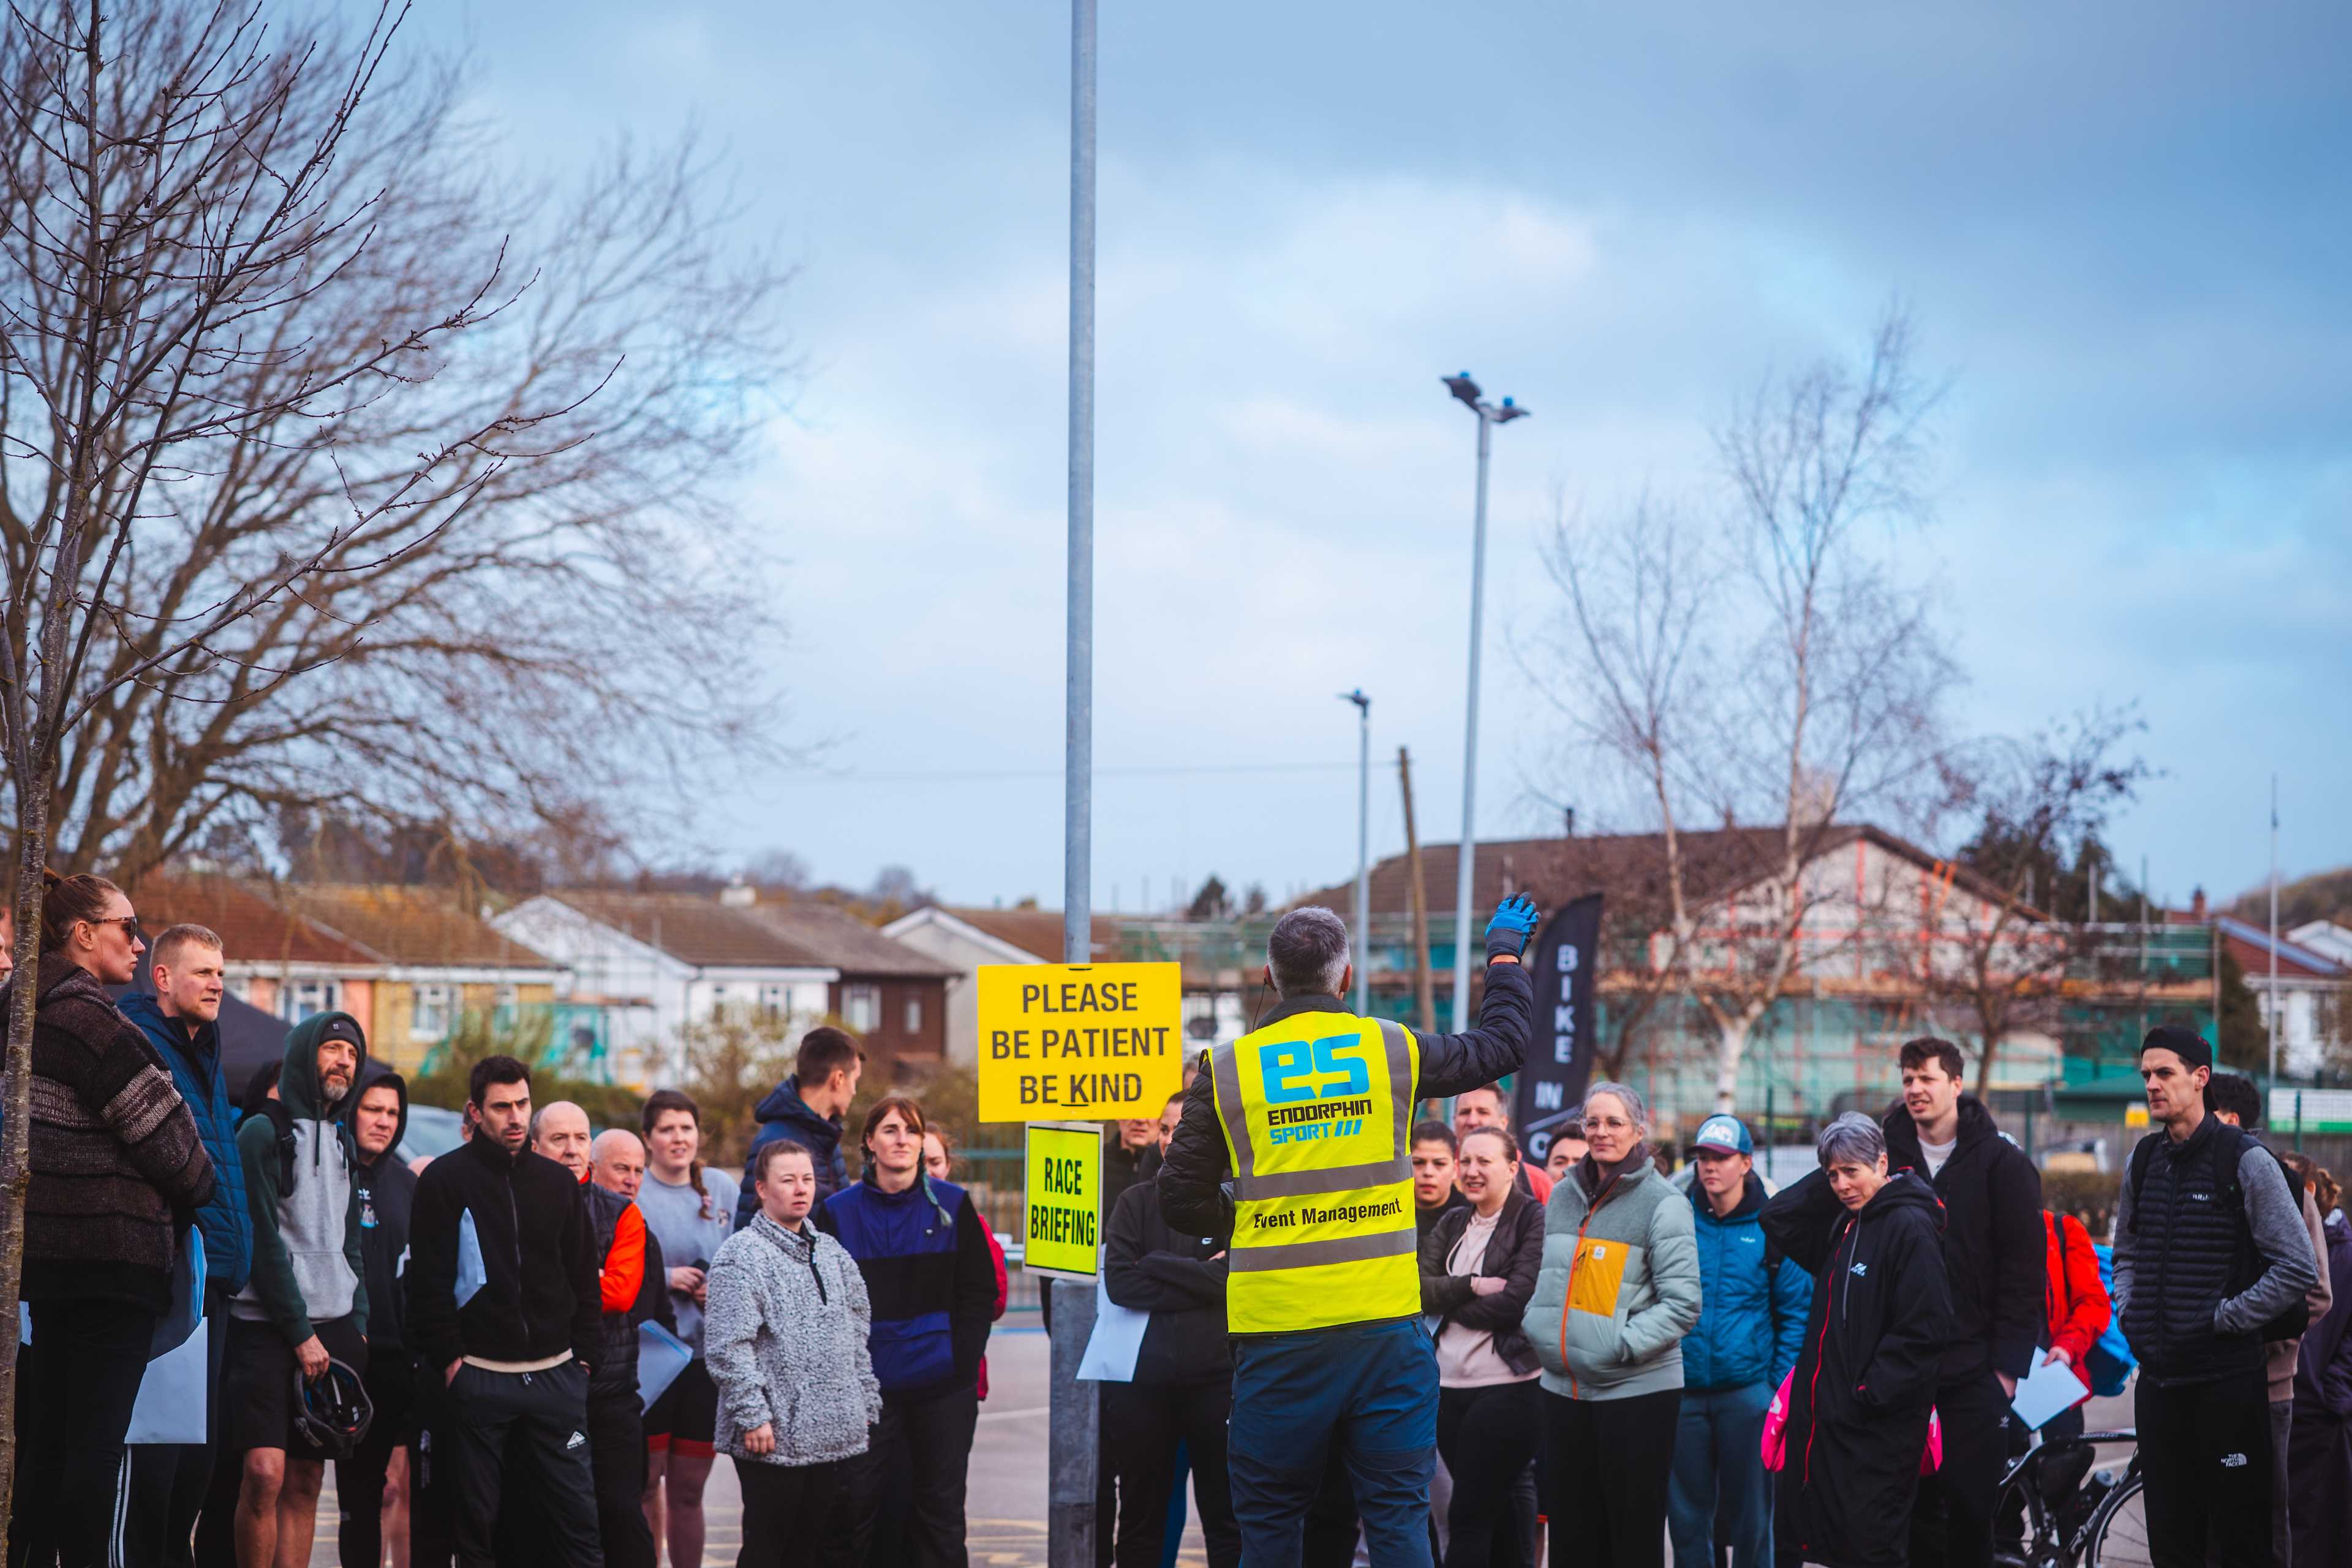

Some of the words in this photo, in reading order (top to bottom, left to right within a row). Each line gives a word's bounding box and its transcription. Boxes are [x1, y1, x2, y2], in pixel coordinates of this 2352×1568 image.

[1022, 982, 1138, 1013] PLEASE
[1554, 944, 1578, 1064] BIKE
[992, 1030, 1030, 1060] BE
[1042, 1027, 1170, 1058] PATIENT
[1020, 1075, 1058, 1104] BE
[1070, 1073, 1142, 1103] KIND
[1535, 1081, 1564, 1110] IN
[1267, 1099, 1373, 1126] ENDORPHIN
[1270, 1121, 1333, 1145] SPORT
[1044, 1157, 1082, 1196] RACE
[1030, 1205, 1095, 1247] BRIEFING
[1254, 1210, 1296, 1229] Event
[1302, 1197, 1403, 1225] Management
